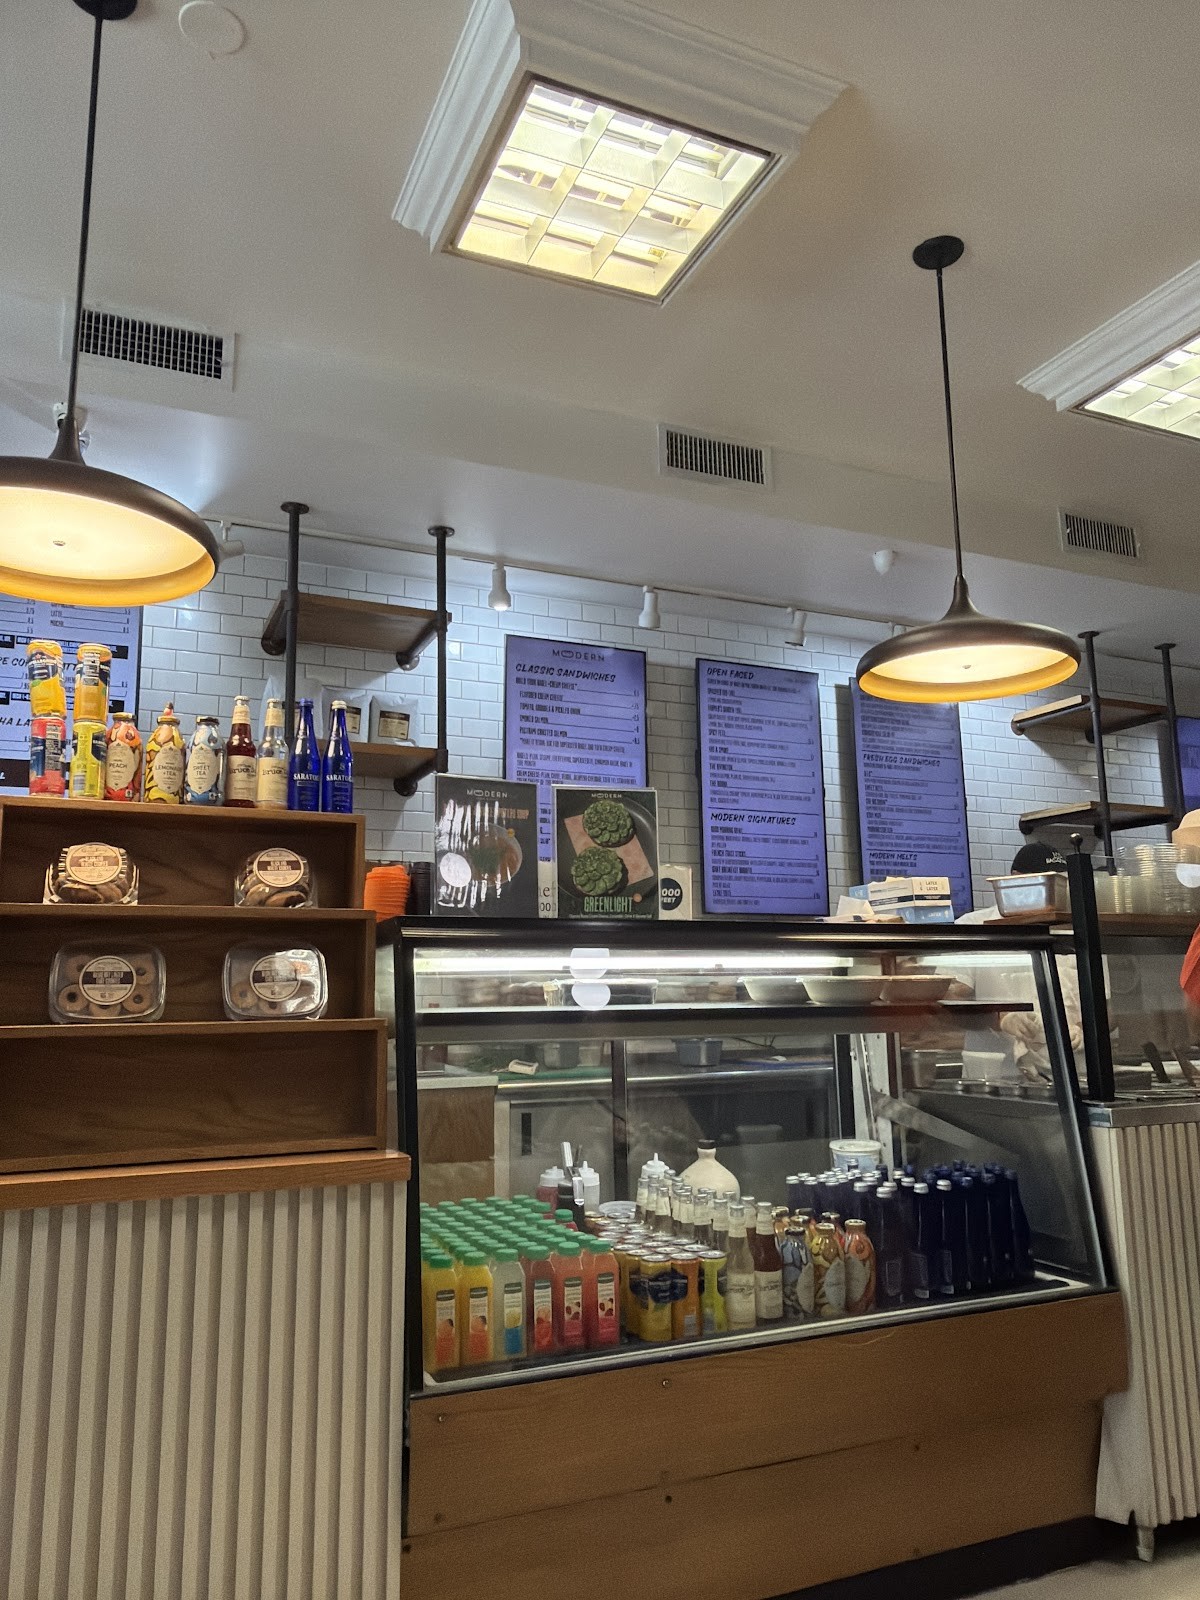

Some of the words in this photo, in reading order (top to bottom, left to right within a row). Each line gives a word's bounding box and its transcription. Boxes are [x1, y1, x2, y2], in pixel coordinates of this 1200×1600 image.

[552, 648, 605, 662] MODERN
[515, 663, 555, 676] CLASSIC
[556, 668, 616, 683] SANDWICHES
[706, 667, 728, 676] OPEN
[730, 669, 754, 680] FACED
[466, 788, 508, 799] MODERN
[710, 812, 745, 823] MODERN
[747, 814, 797, 826] SIGNATURES
[583, 896, 634, 913] GREENLIGHT
